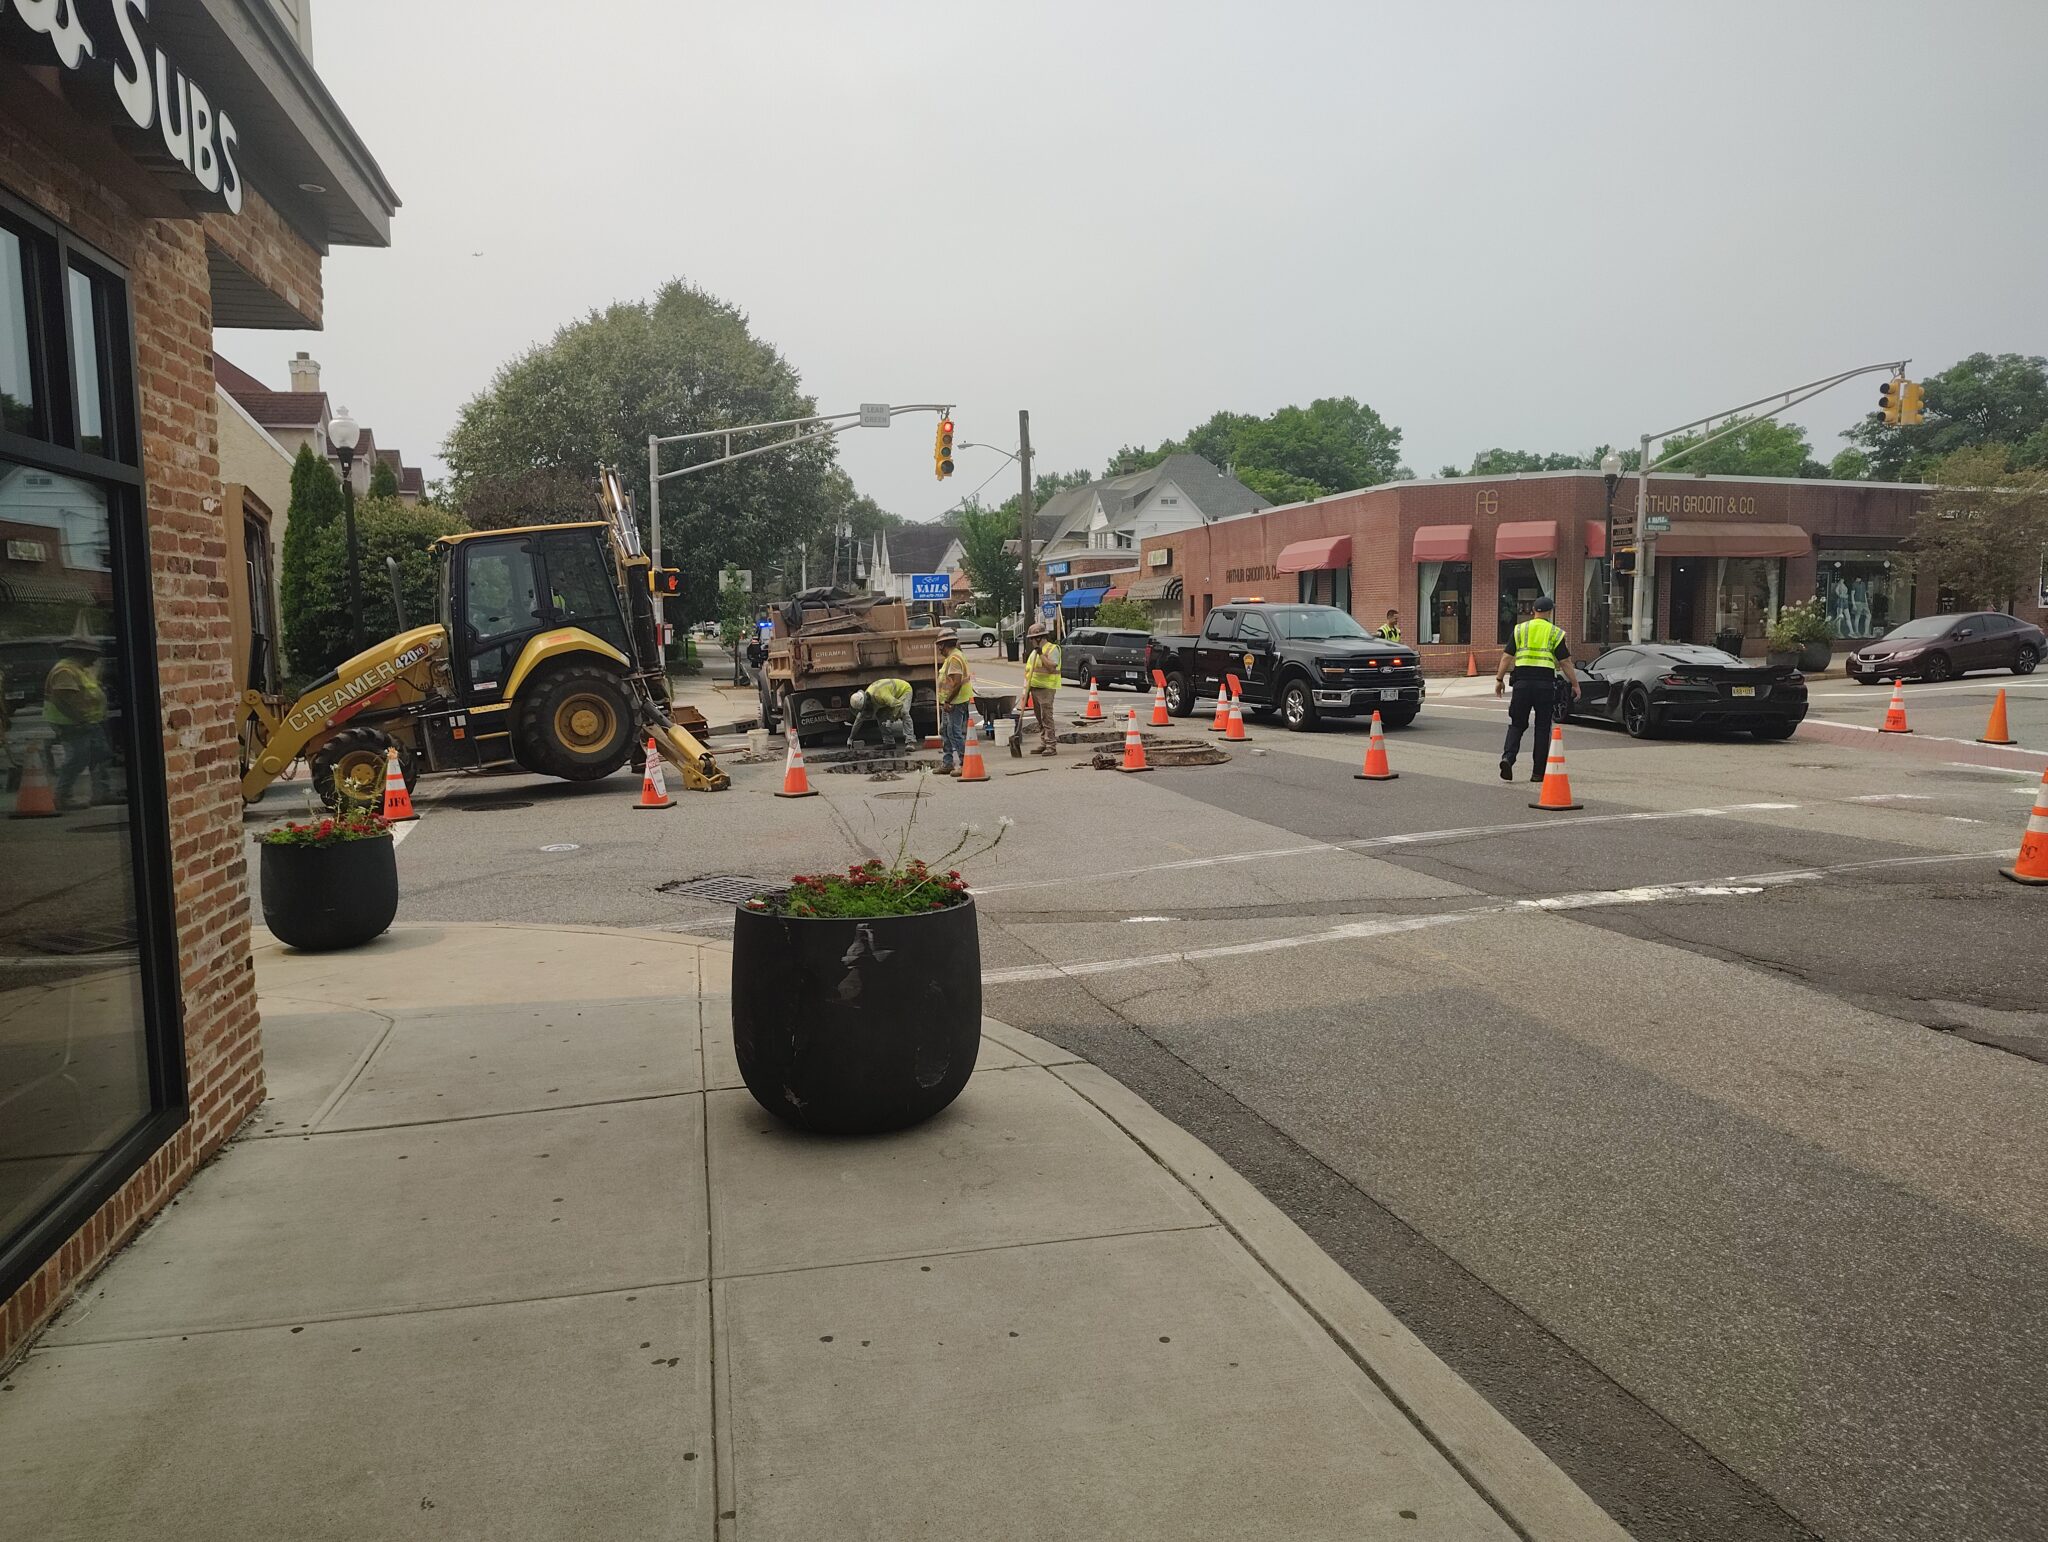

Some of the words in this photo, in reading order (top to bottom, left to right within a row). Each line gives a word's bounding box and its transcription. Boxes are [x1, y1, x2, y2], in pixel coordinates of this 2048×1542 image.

[1682, 495, 1724, 514] GROOM
[1727, 496, 1737, 514] &
[1739, 496, 1758, 515] CO.
[914, 583, 949, 594] NAILS
[288, 660, 396, 732] CREAMER
[387, 797, 408, 808] JFC
